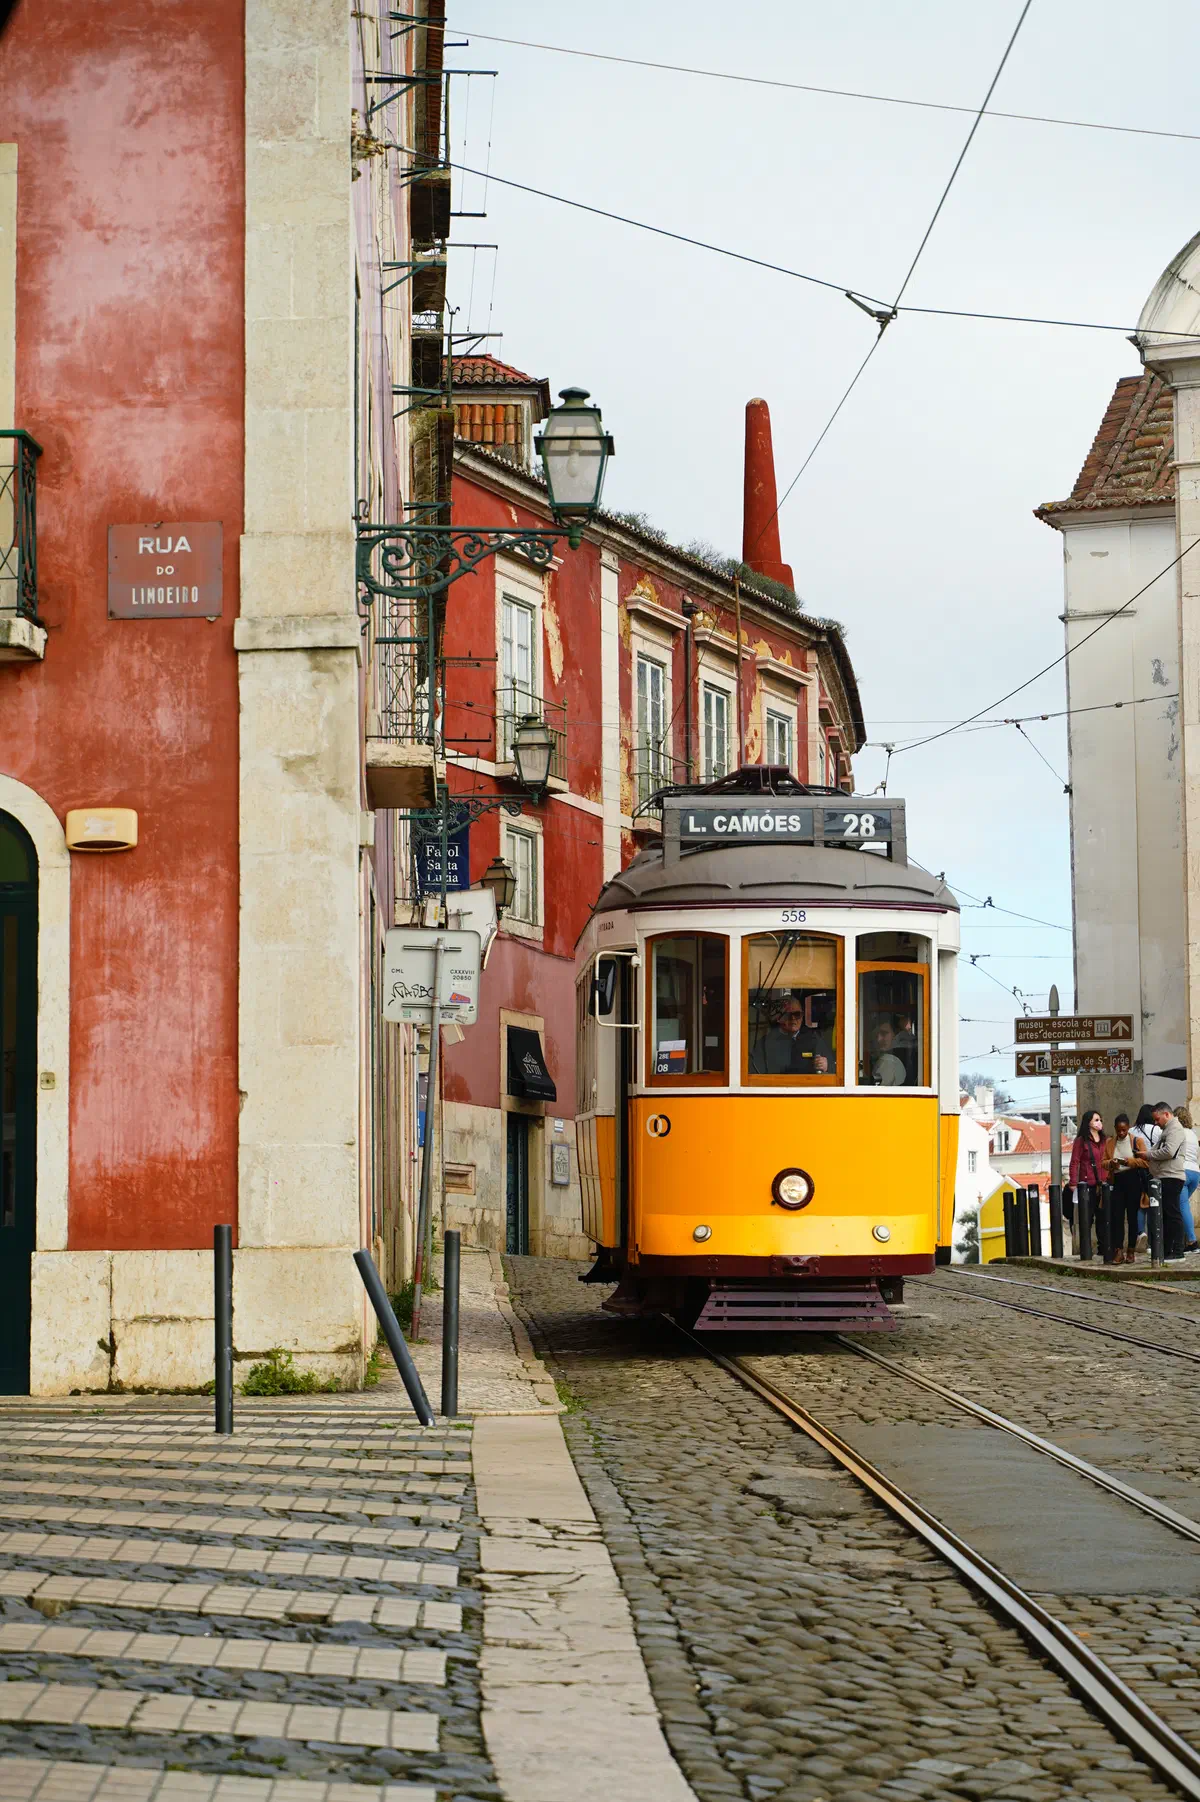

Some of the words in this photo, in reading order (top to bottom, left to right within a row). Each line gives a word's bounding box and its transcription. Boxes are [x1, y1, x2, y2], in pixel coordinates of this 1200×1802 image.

[138, 536, 192, 554] RUA
[156, 565, 175, 575] DO
[131, 586, 199, 605] LIMOEIRO
[688, 815, 707, 833] L.
[843, 813, 876, 837] 28
[426, 845, 459, 857] Faol
[427, 859, 458, 870] Sata
[781, 909, 807, 922] 558
[1018, 1020, 1044, 1029] museu
[1052, 1019, 1079, 1028] escola
[1082, 1018, 1093, 1027] de
[1018, 1030, 1039, 1040] artes
[1042, 1030, 1091, 1039] decorativas
[1052, 1056, 1081, 1066] castelo
[1084, 1056, 1094, 1066] de
[657, 1063, 669, 1073] 08
